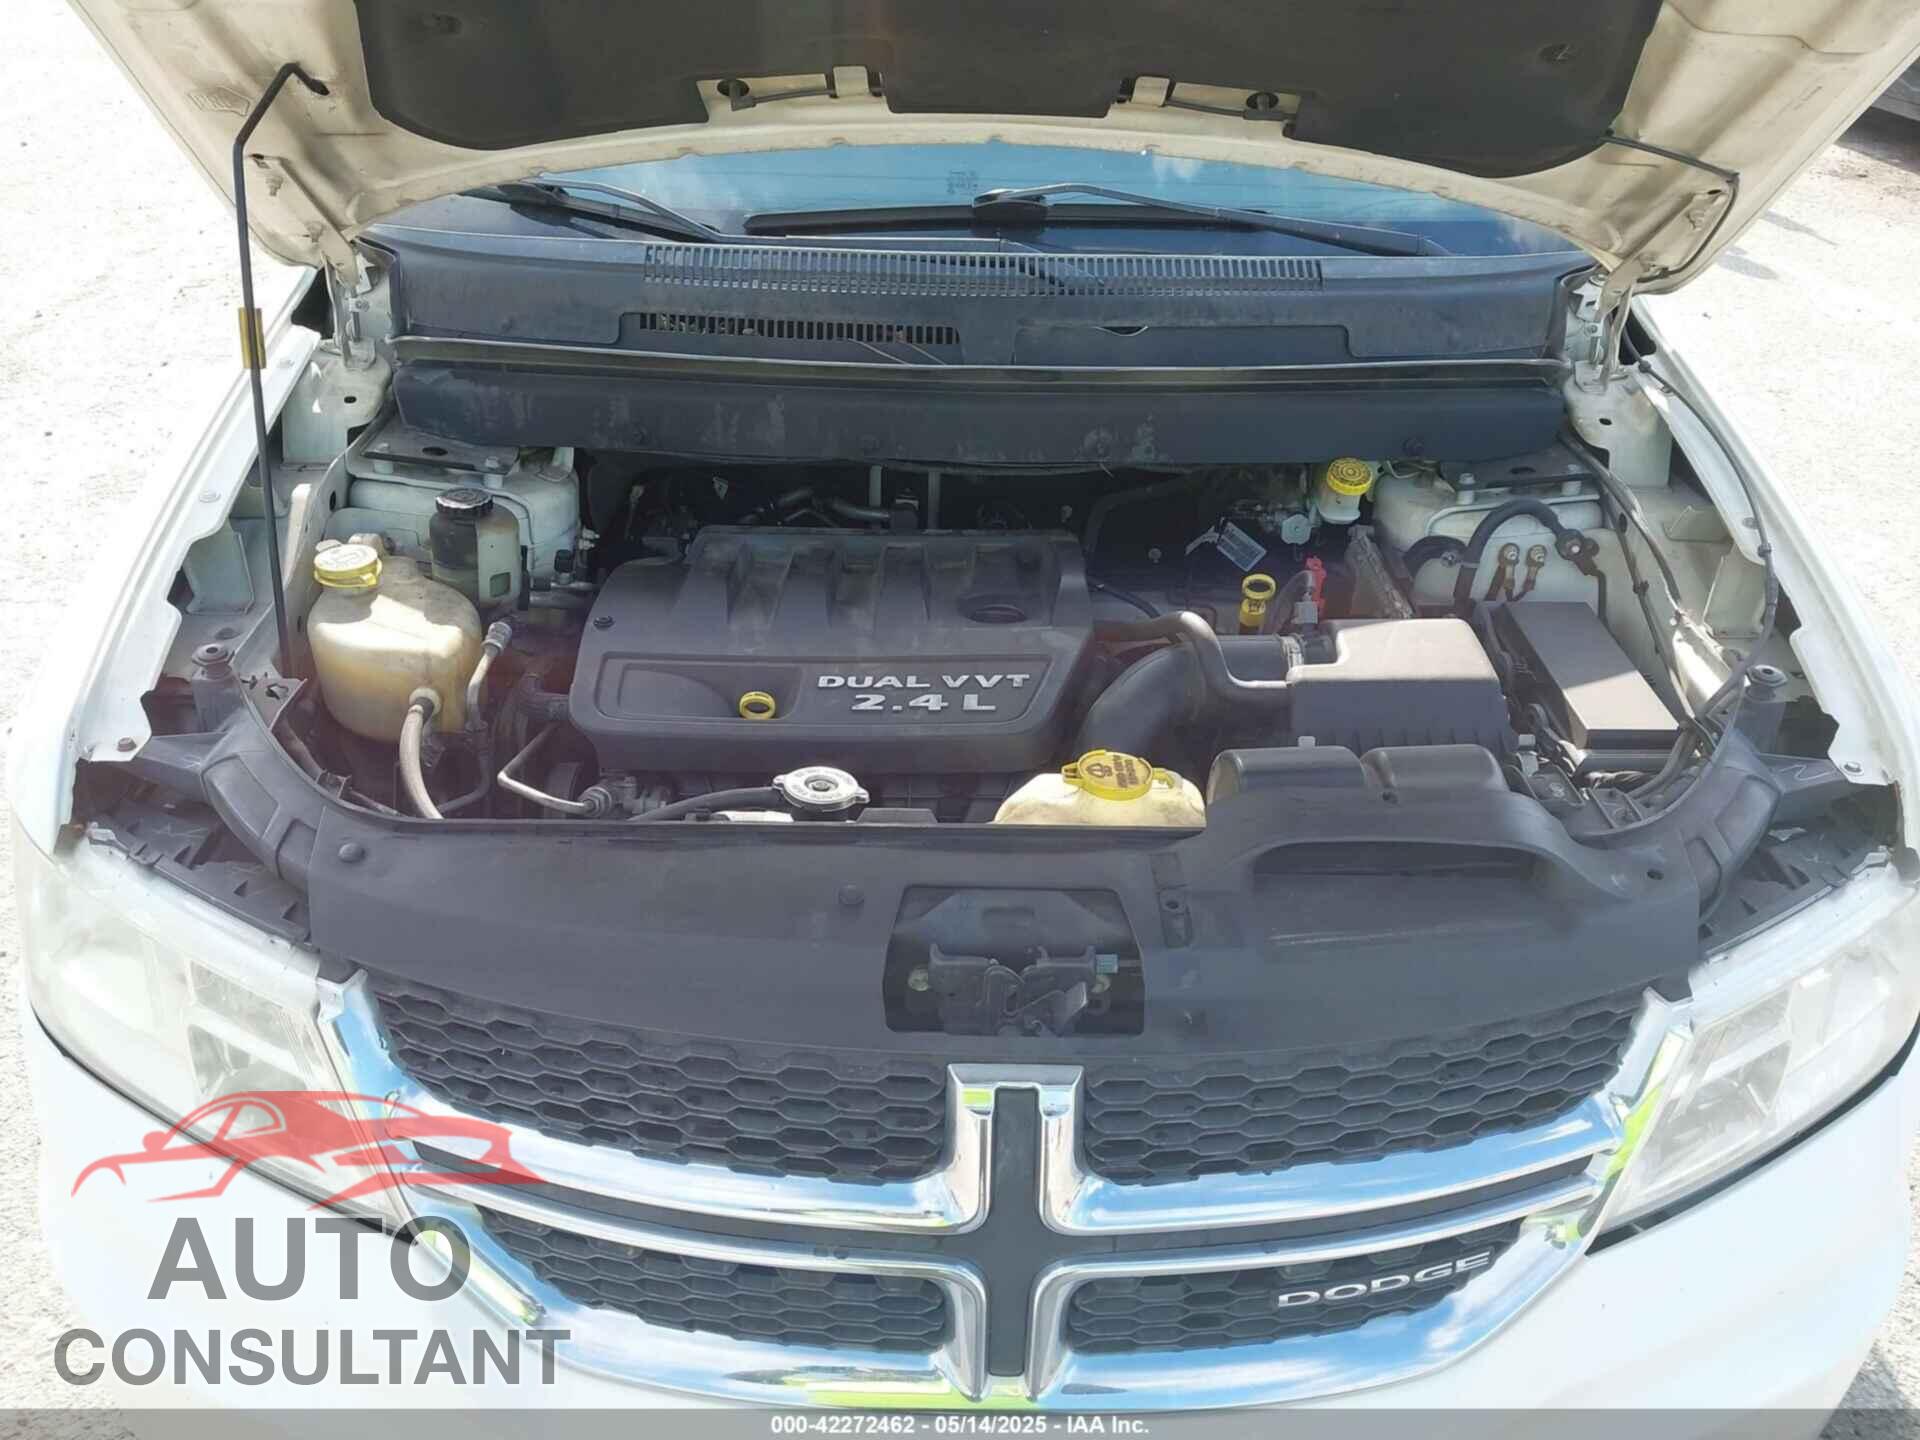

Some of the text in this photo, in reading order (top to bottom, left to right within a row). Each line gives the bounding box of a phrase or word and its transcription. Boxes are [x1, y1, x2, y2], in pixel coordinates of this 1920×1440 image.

[816, 673, 1031, 689] DUAL VVT
[850, 693, 997, 712] 2.4 L
[1277, 1250, 1492, 1308] DODGE
